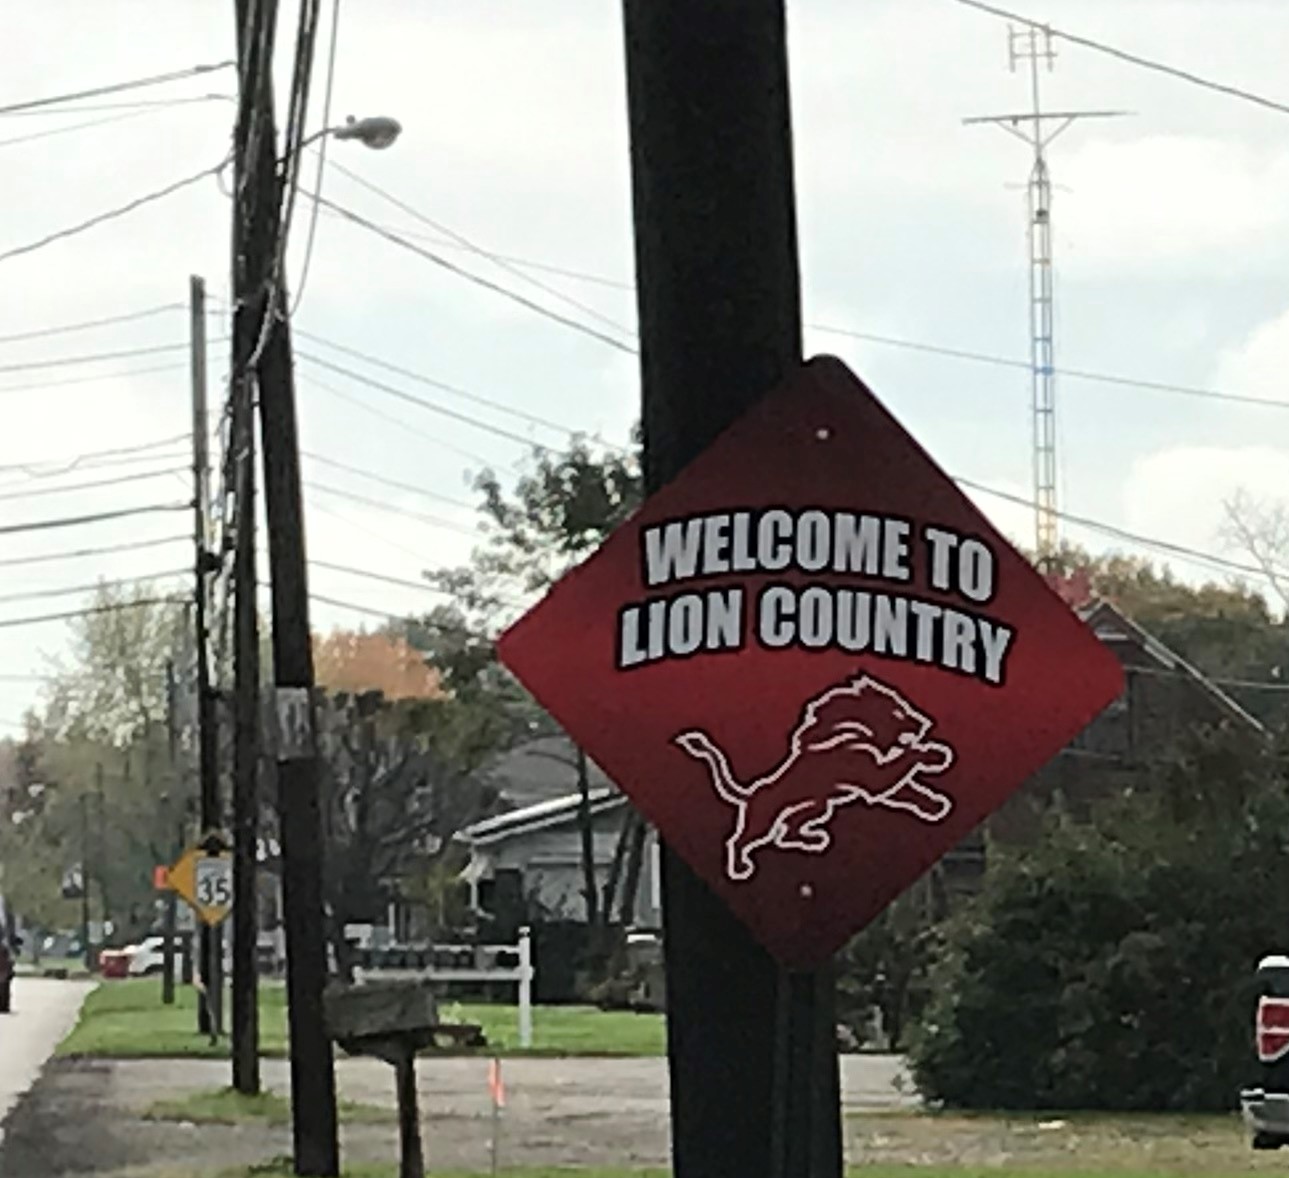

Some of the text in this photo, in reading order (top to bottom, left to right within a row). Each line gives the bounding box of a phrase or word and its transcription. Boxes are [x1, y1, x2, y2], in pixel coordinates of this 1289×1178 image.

[645, 510, 993, 600] WELCOME TO
[620, 586, 1012, 684] LION COUNTRY
[198, 876, 231, 904] 35
